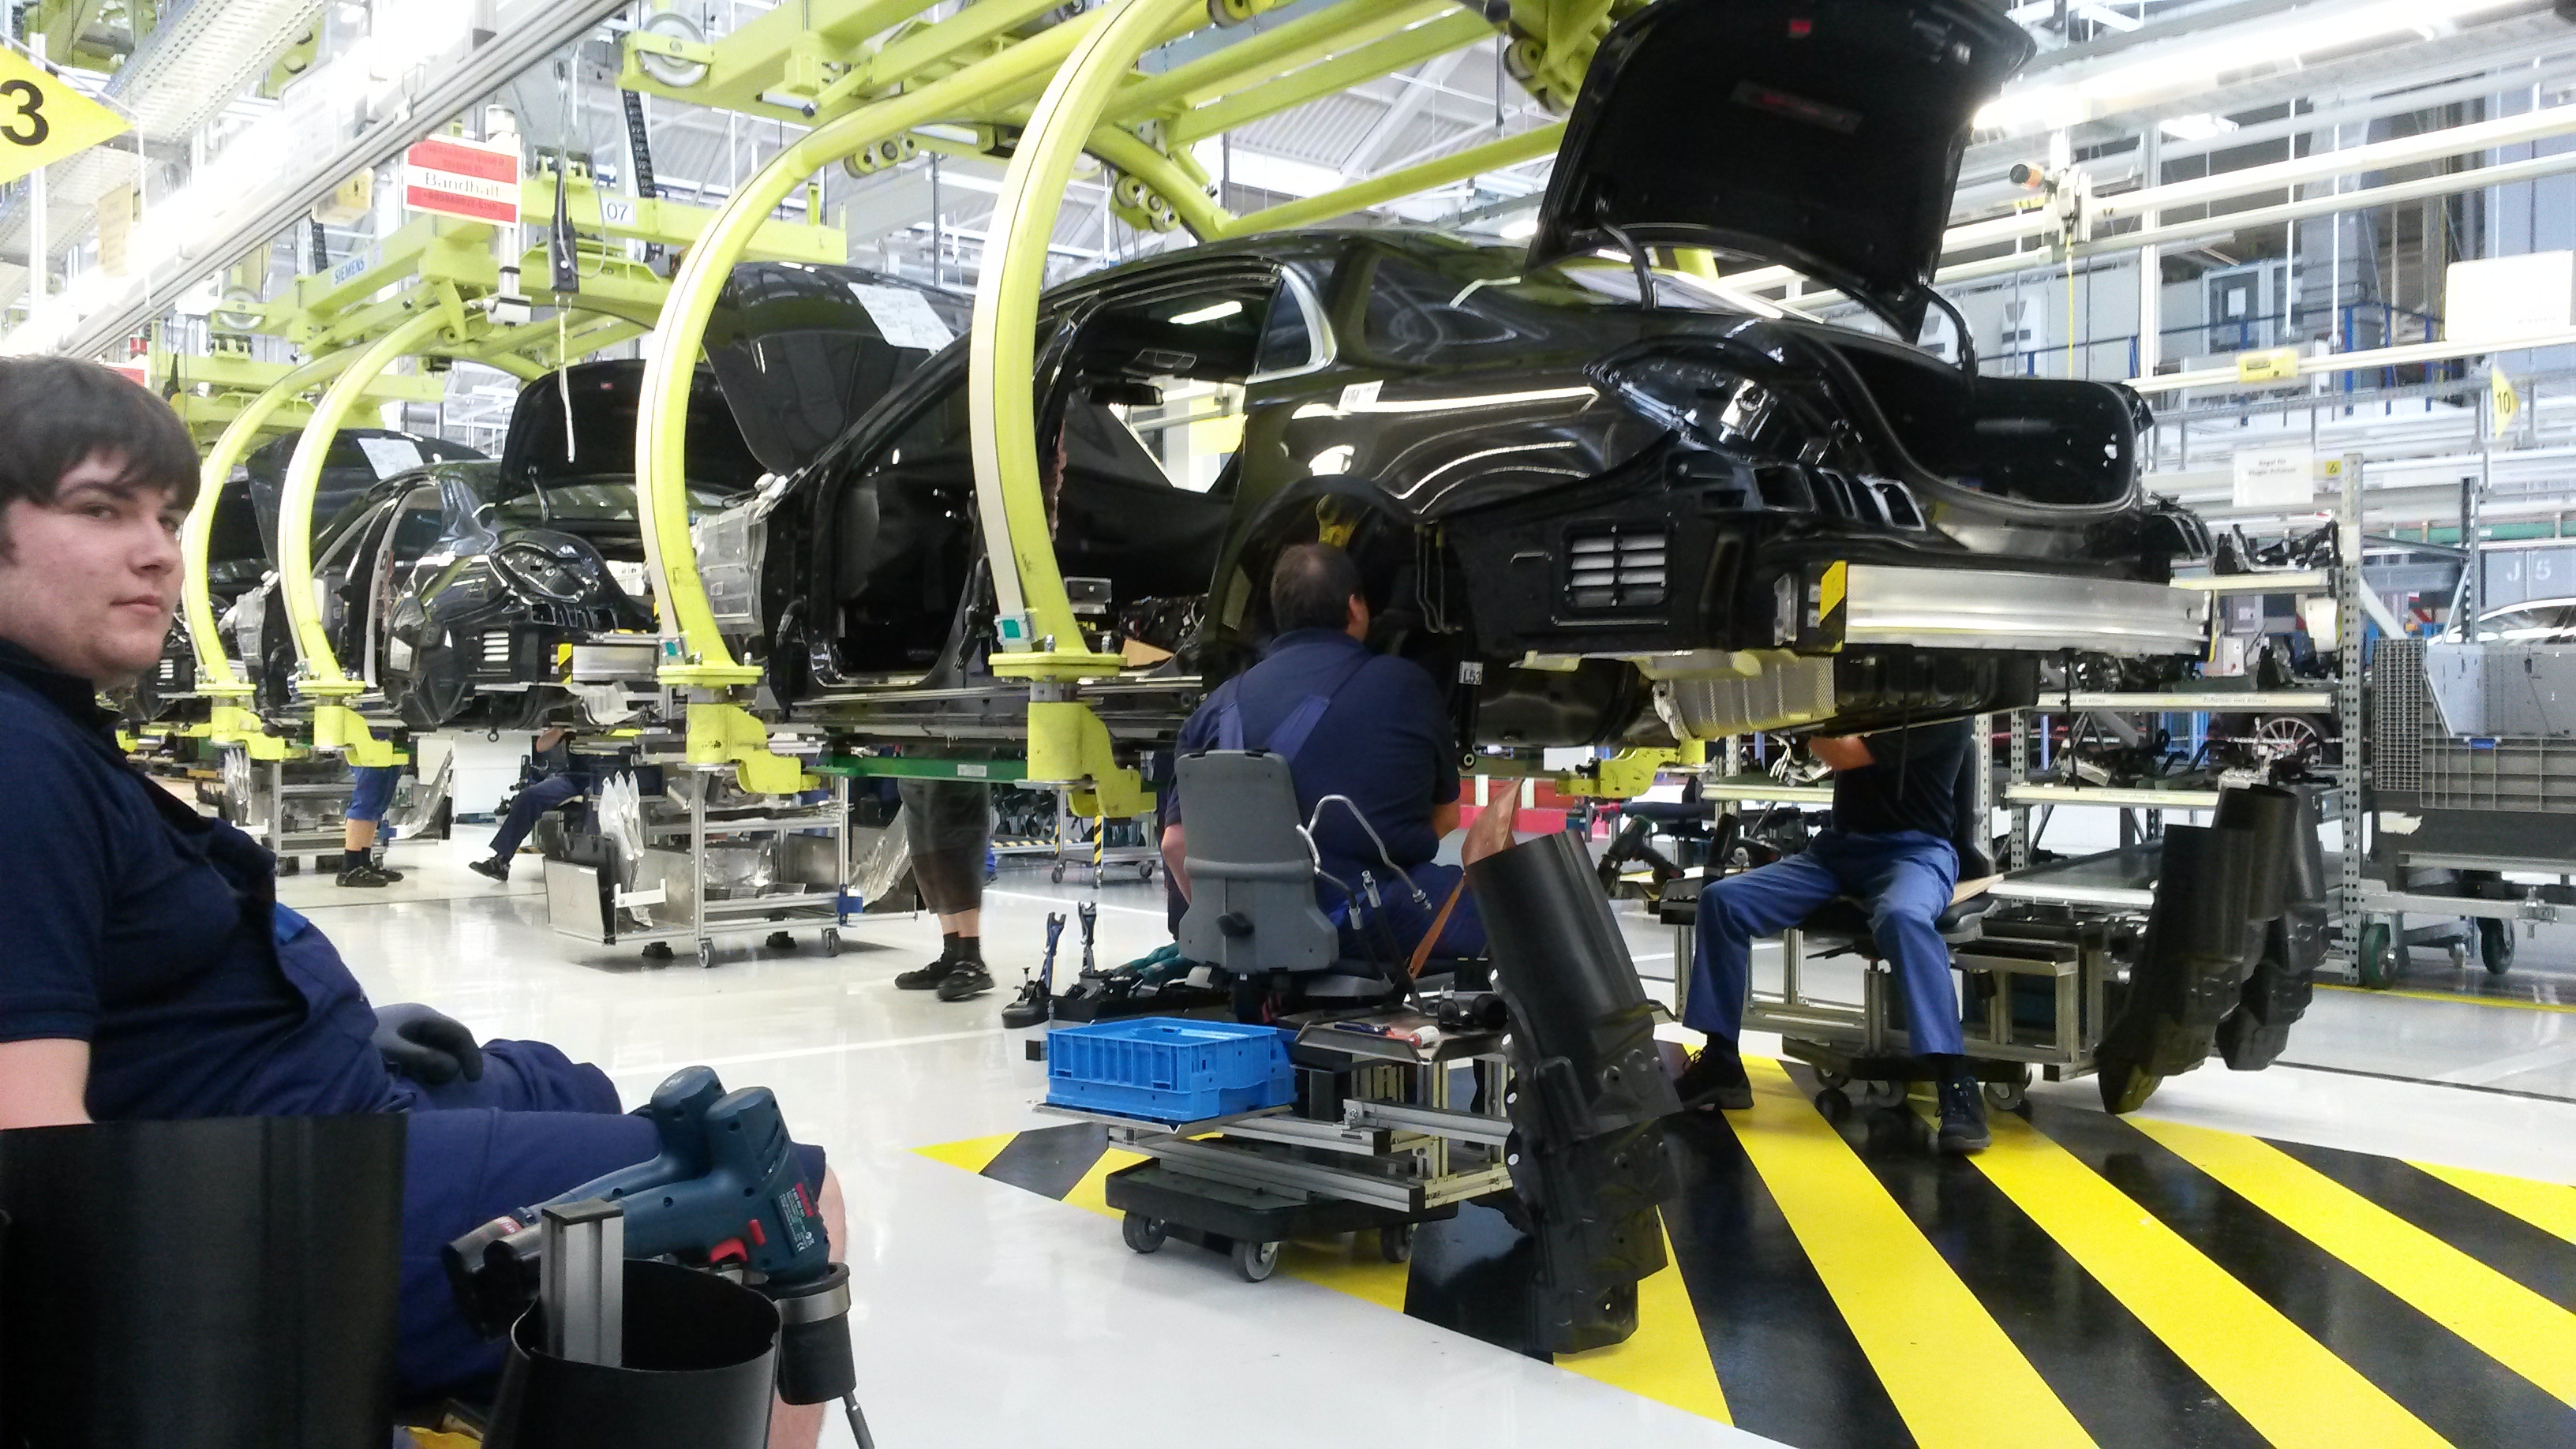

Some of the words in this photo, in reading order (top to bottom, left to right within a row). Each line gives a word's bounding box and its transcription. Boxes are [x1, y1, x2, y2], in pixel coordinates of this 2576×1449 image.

[0, 79, 49, 146] 3
[425, 172, 500, 197] Bandhalt
[606, 201, 629, 221] 07
[335, 254, 365, 285] SIEMENS
[2496, 391, 2510, 415] 10
